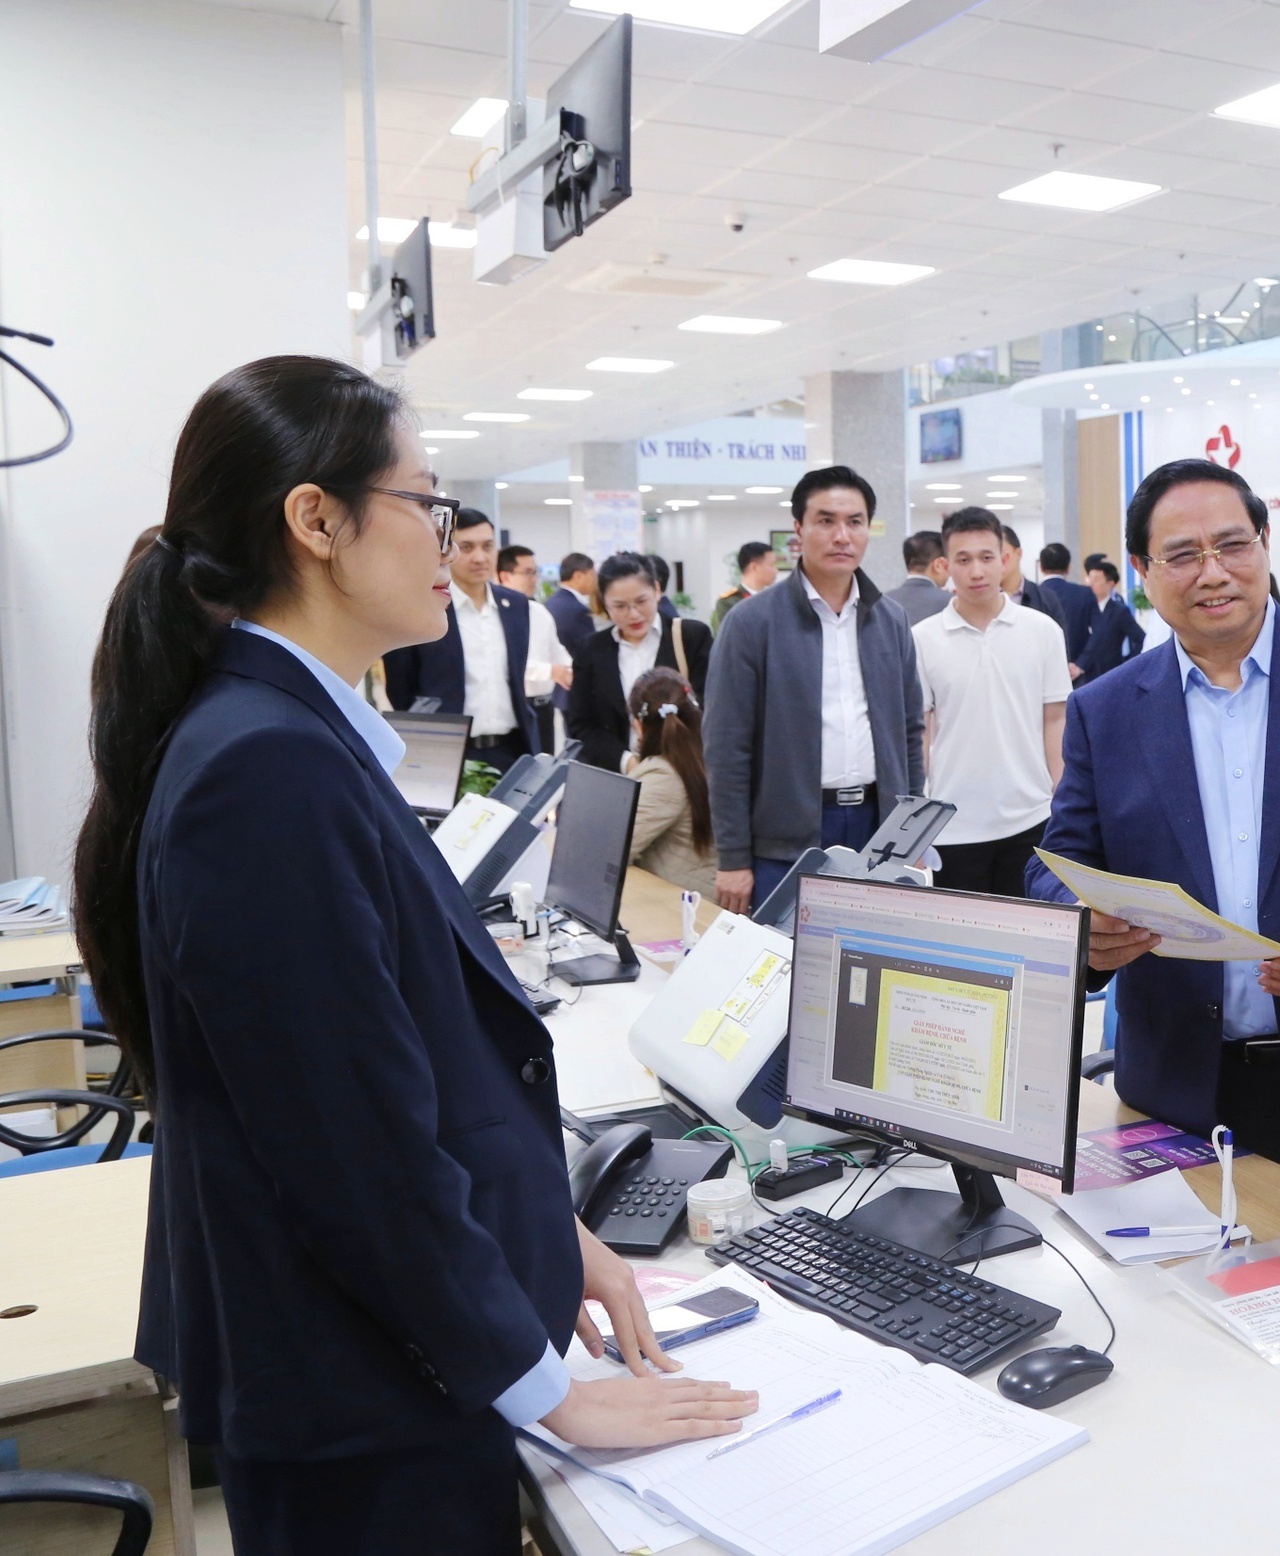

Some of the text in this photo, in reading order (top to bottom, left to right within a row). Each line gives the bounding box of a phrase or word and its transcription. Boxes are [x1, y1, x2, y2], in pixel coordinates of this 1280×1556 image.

[665, 438, 712, 460] THIỆN
[728, 440, 774, 460] TRÁCH
[903, 1140, 918, 1150] DELL
